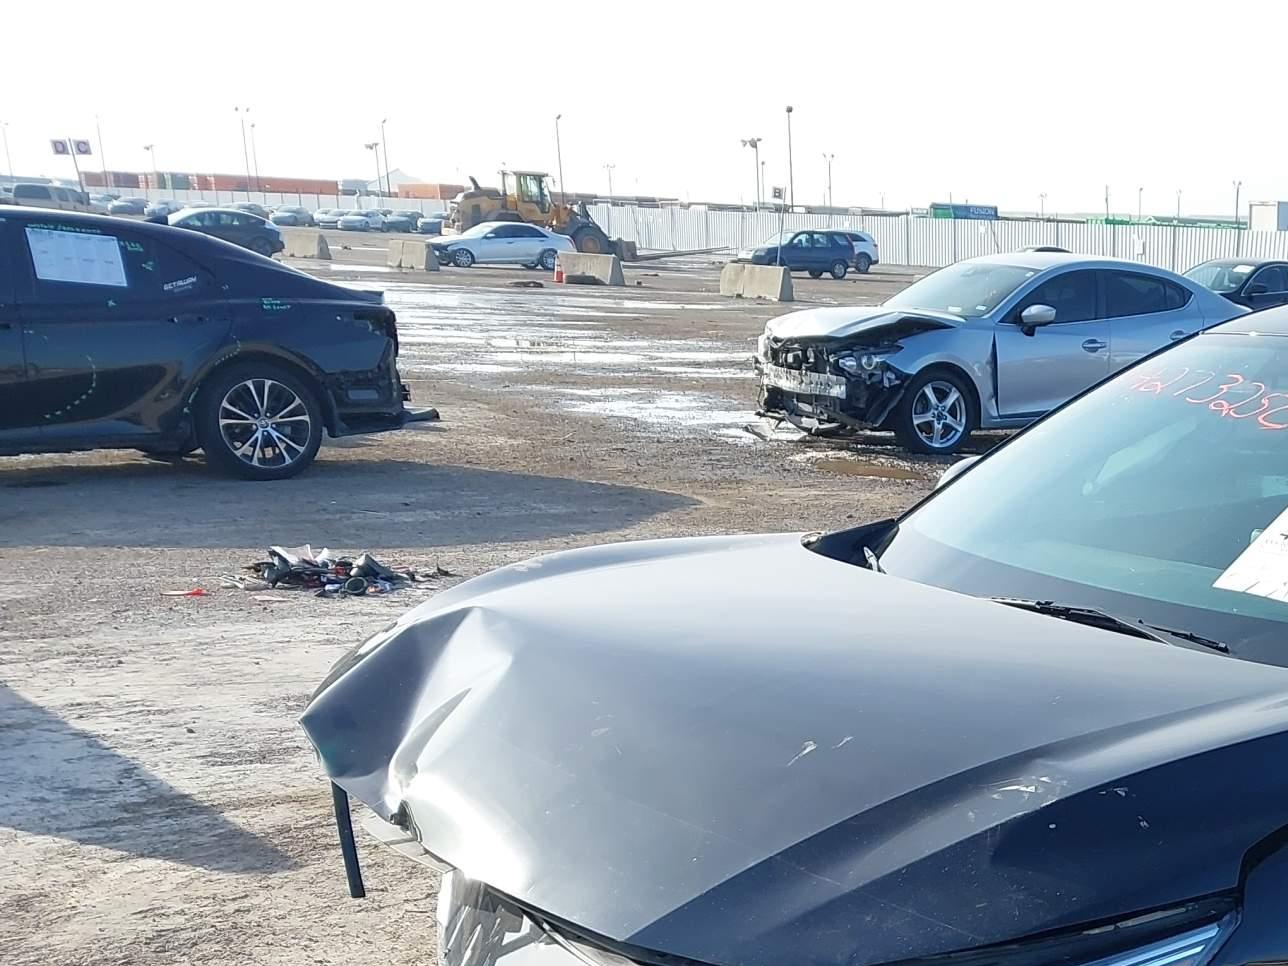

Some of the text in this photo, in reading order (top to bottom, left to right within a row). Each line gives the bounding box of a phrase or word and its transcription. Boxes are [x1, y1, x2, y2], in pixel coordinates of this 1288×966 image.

[54, 141, 65, 154] D
[76, 141, 89, 154] C
[773, 187, 782, 198] B
